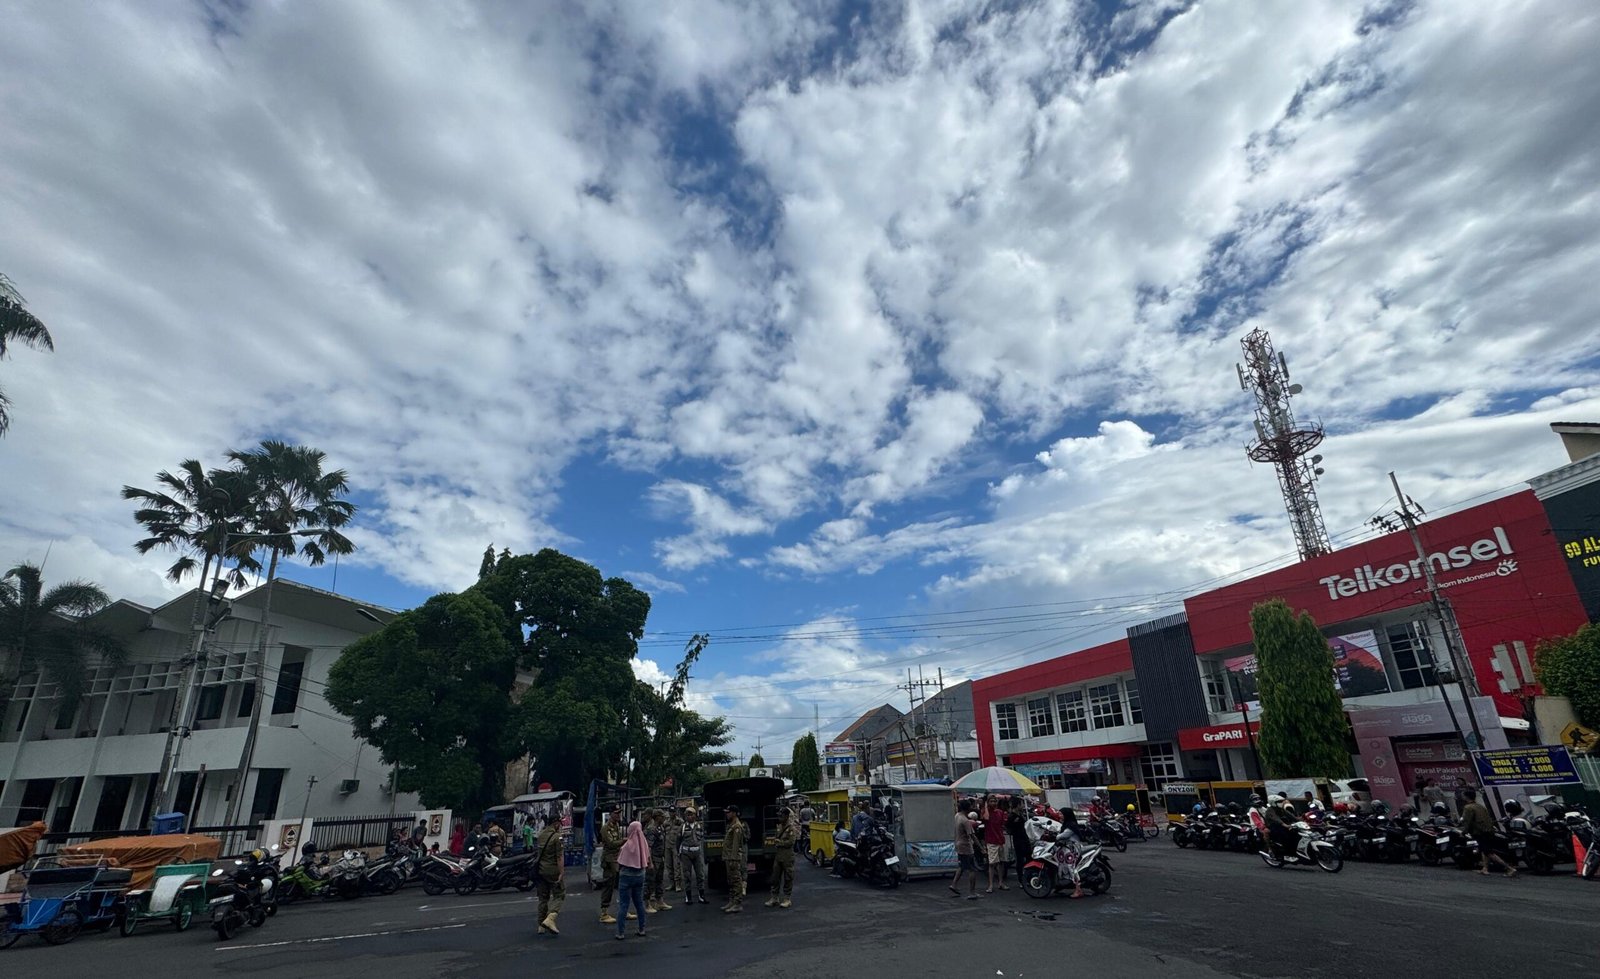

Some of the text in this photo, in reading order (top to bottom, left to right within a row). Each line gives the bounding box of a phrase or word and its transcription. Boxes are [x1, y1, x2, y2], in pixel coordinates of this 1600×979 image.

[1564, 536, 1600, 559] SD AL
[1319, 526, 1514, 600] Telkomsel
[1457, 570, 1496, 585] Indonesia
[1203, 729, 1243, 742] GraPARI
